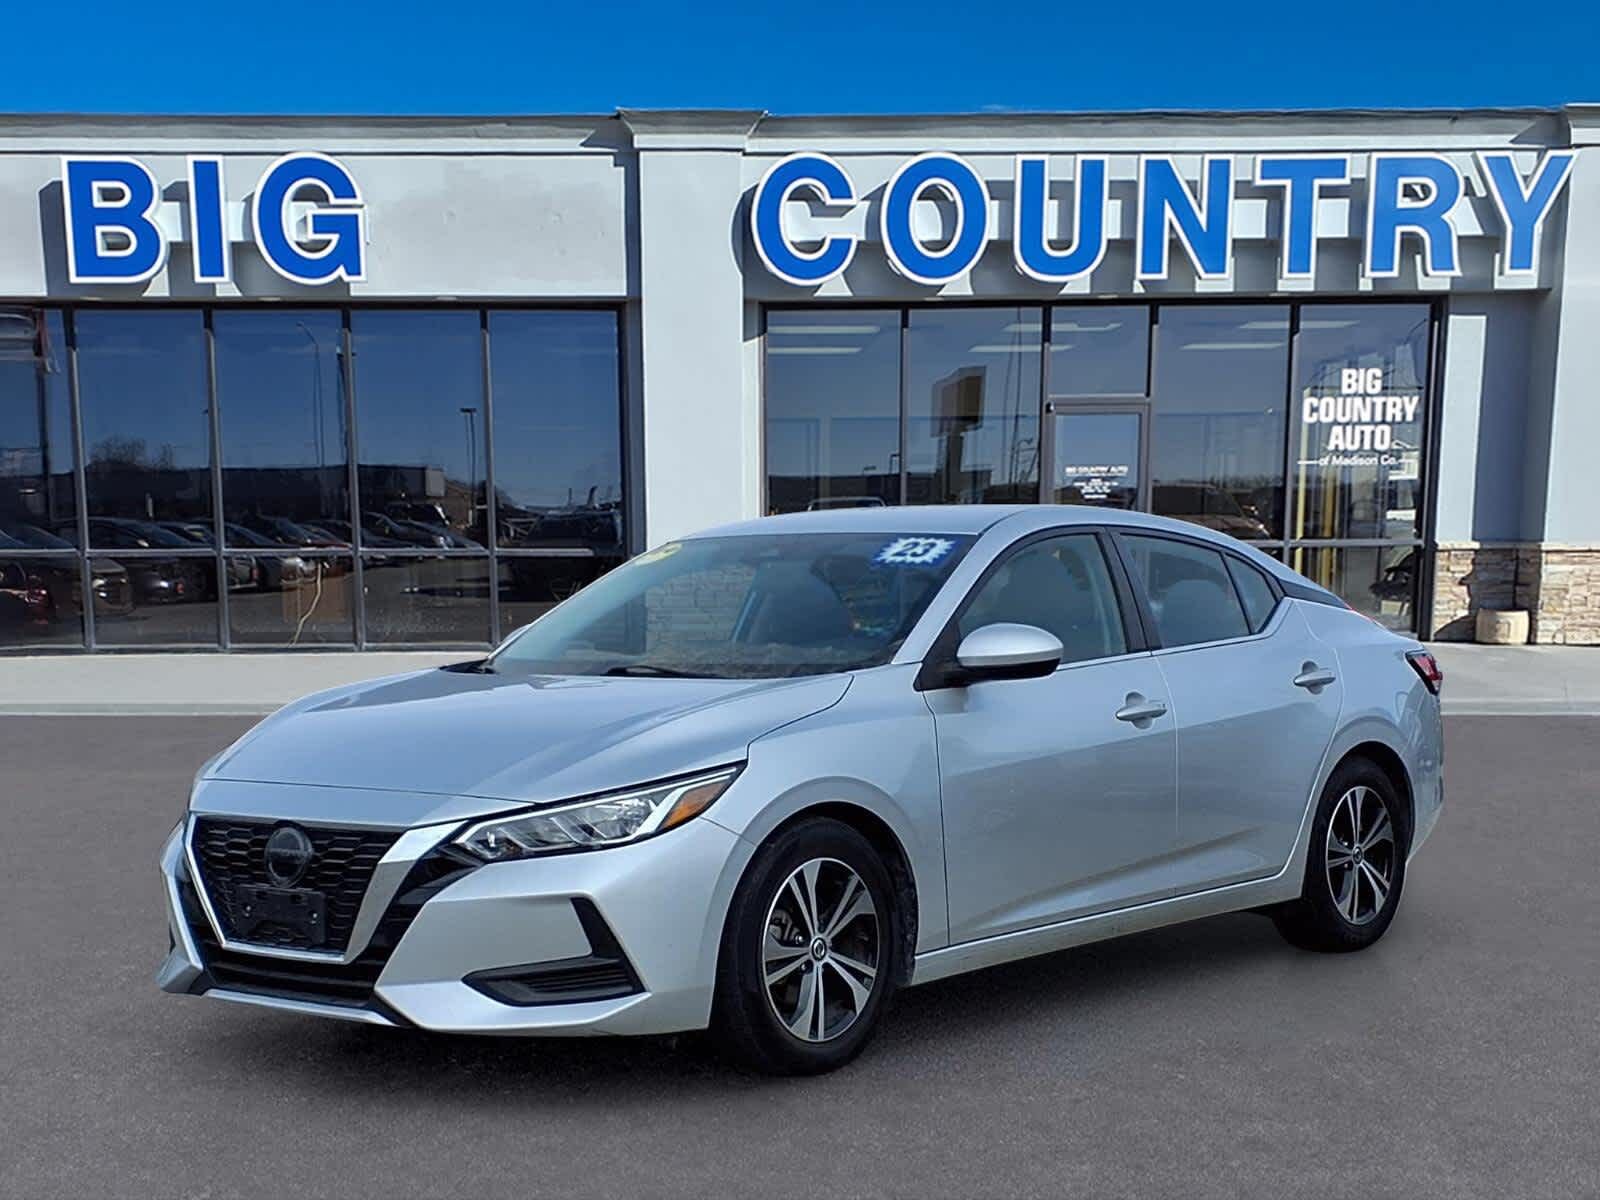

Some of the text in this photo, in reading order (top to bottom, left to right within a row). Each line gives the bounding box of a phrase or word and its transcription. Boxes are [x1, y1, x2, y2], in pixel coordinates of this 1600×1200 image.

[61, 151, 1576, 287] BIG COUNTRY
[1341, 368, 1383, 395] BIG
[1303, 396, 1419, 423] COUNTRY
[1328, 425, 1392, 451] AUTO
[1318, 454, 1329, 466] of
[1332, 455, 1378, 466] Madison
[891, 541, 937, 558] 23
